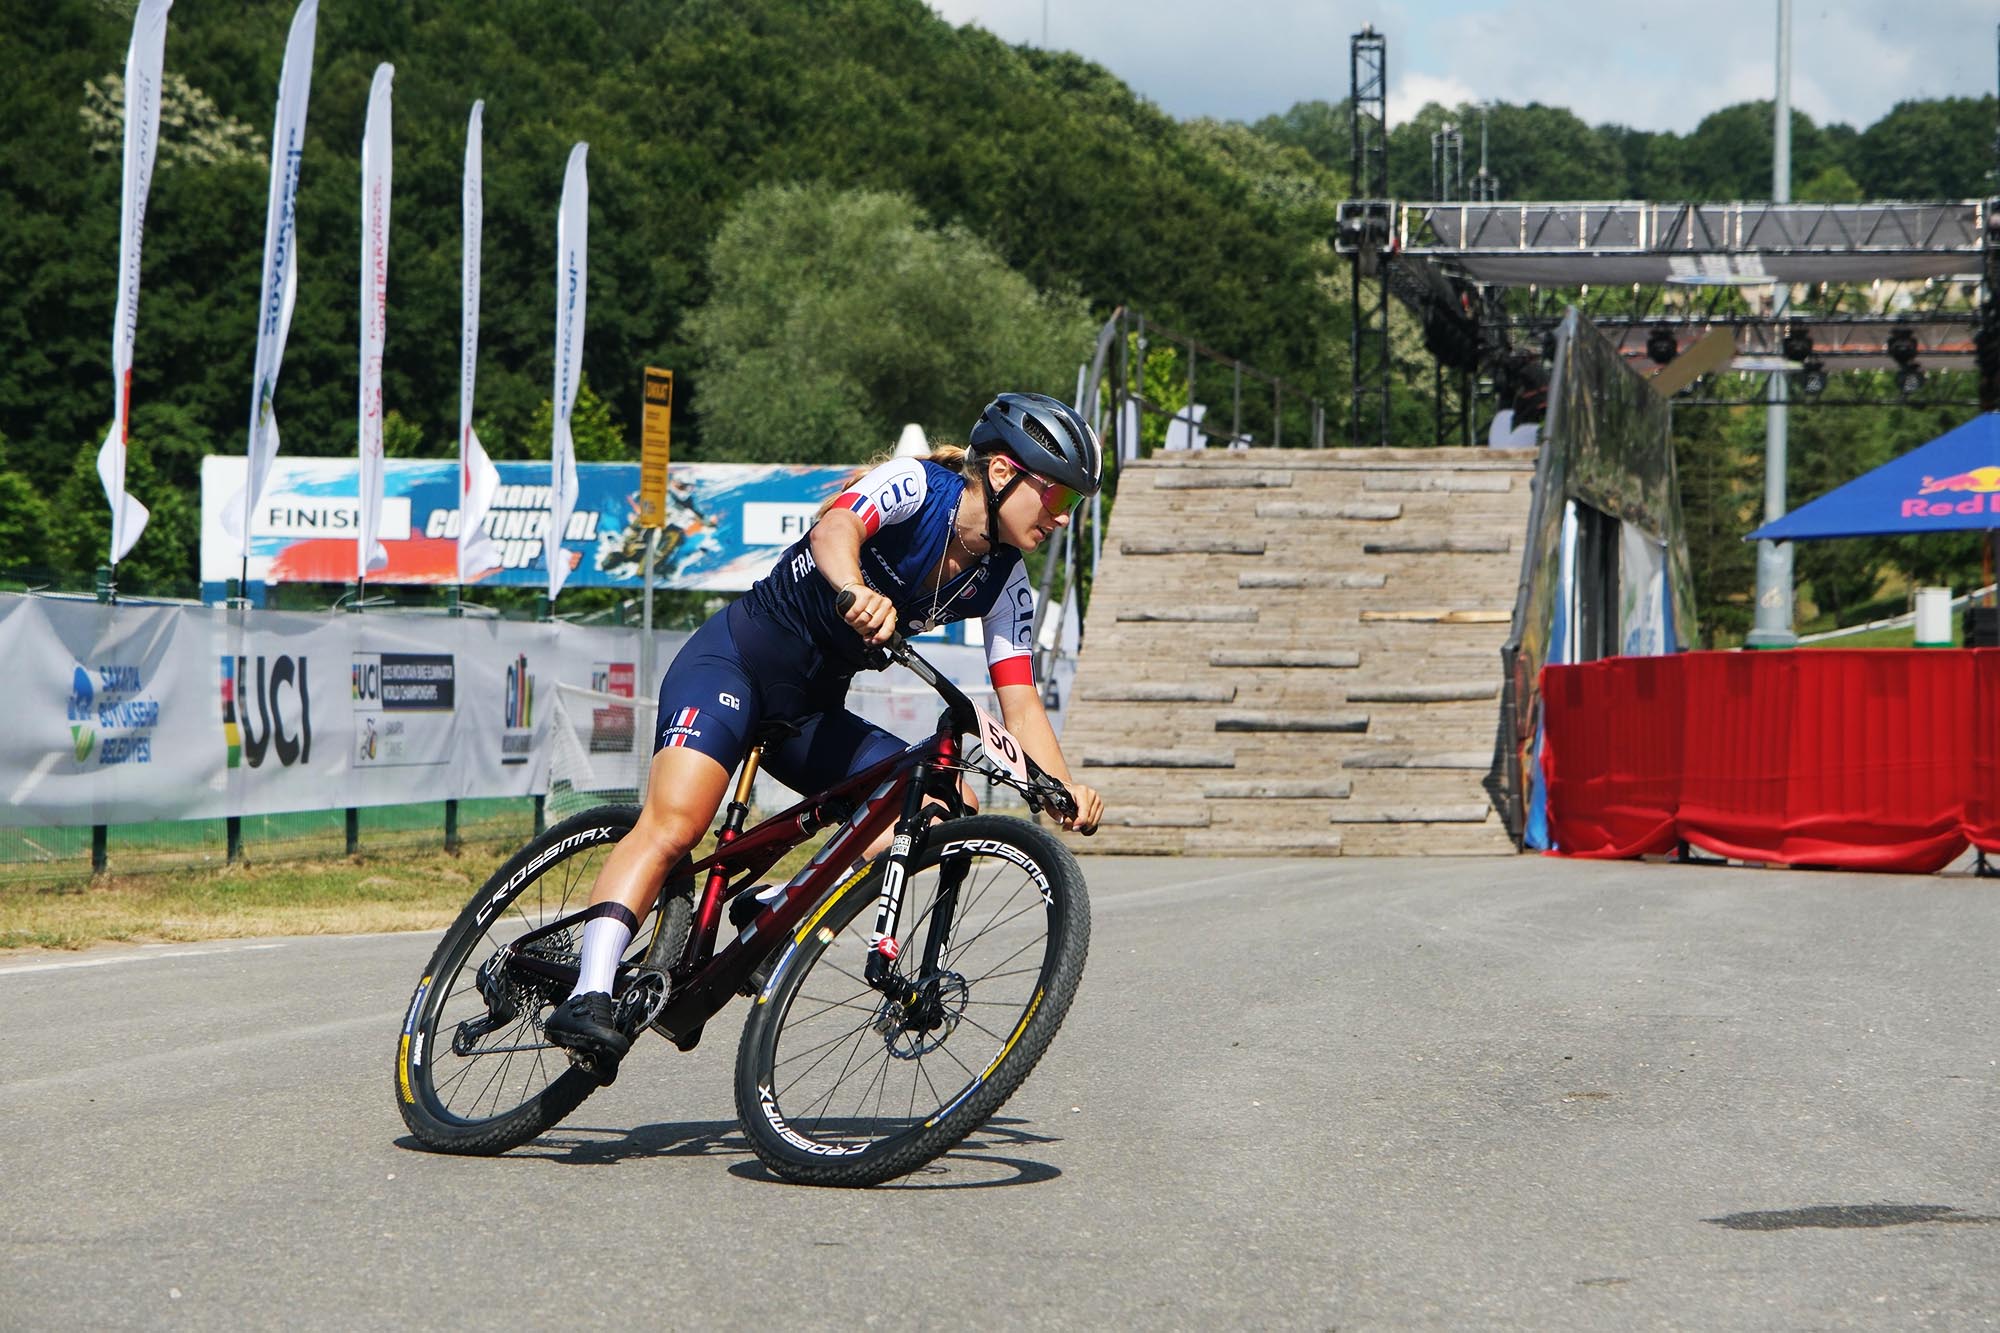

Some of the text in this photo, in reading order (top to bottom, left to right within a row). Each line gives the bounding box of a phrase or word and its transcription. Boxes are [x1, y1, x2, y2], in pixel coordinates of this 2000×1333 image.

[881, 477, 918, 513] CIC
[1902, 494, 1983, 518] Red
[426, 509, 599, 540] COTINENAL
[871, 547, 905, 586] LOOK
[1017, 587, 1034, 643] CIC
[358, 664, 379, 700] UCI
[238, 655, 311, 768] UCI
[663, 727, 701, 737] CORIMA
[988, 721, 1017, 763] 50
[477, 826, 613, 926] CROSSMAX
[941, 839, 1055, 905] CROSSMAX
[758, 1084, 872, 1157] CROSSMAX
